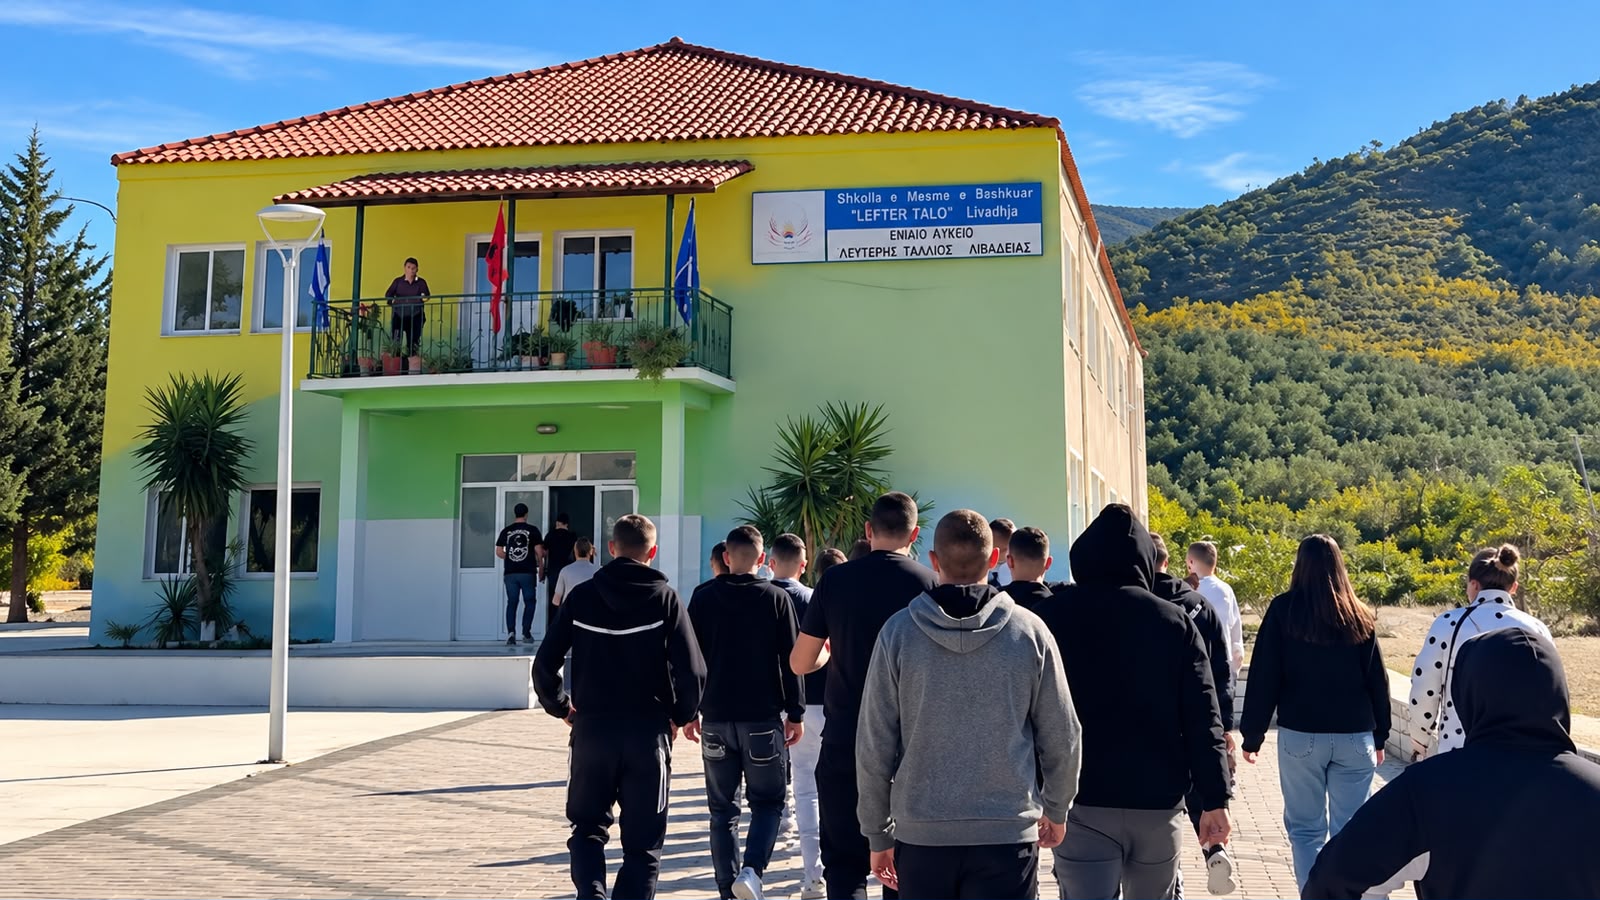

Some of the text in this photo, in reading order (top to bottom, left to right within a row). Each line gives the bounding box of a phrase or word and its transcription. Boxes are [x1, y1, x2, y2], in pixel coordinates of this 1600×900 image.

[837, 187, 1034, 204] Shkolla e Mesme e Bashkuar
[851, 204, 1018, 222] "LEFTER TALO" Livadhja
[889, 228, 927, 241] ΕΝΙΑΙΟ
[903, 244, 953, 257] ΤΑΛΛΙΟΣ
[969, 242, 1031, 255] ΛΙΒΑΔΕΙΑΣ
